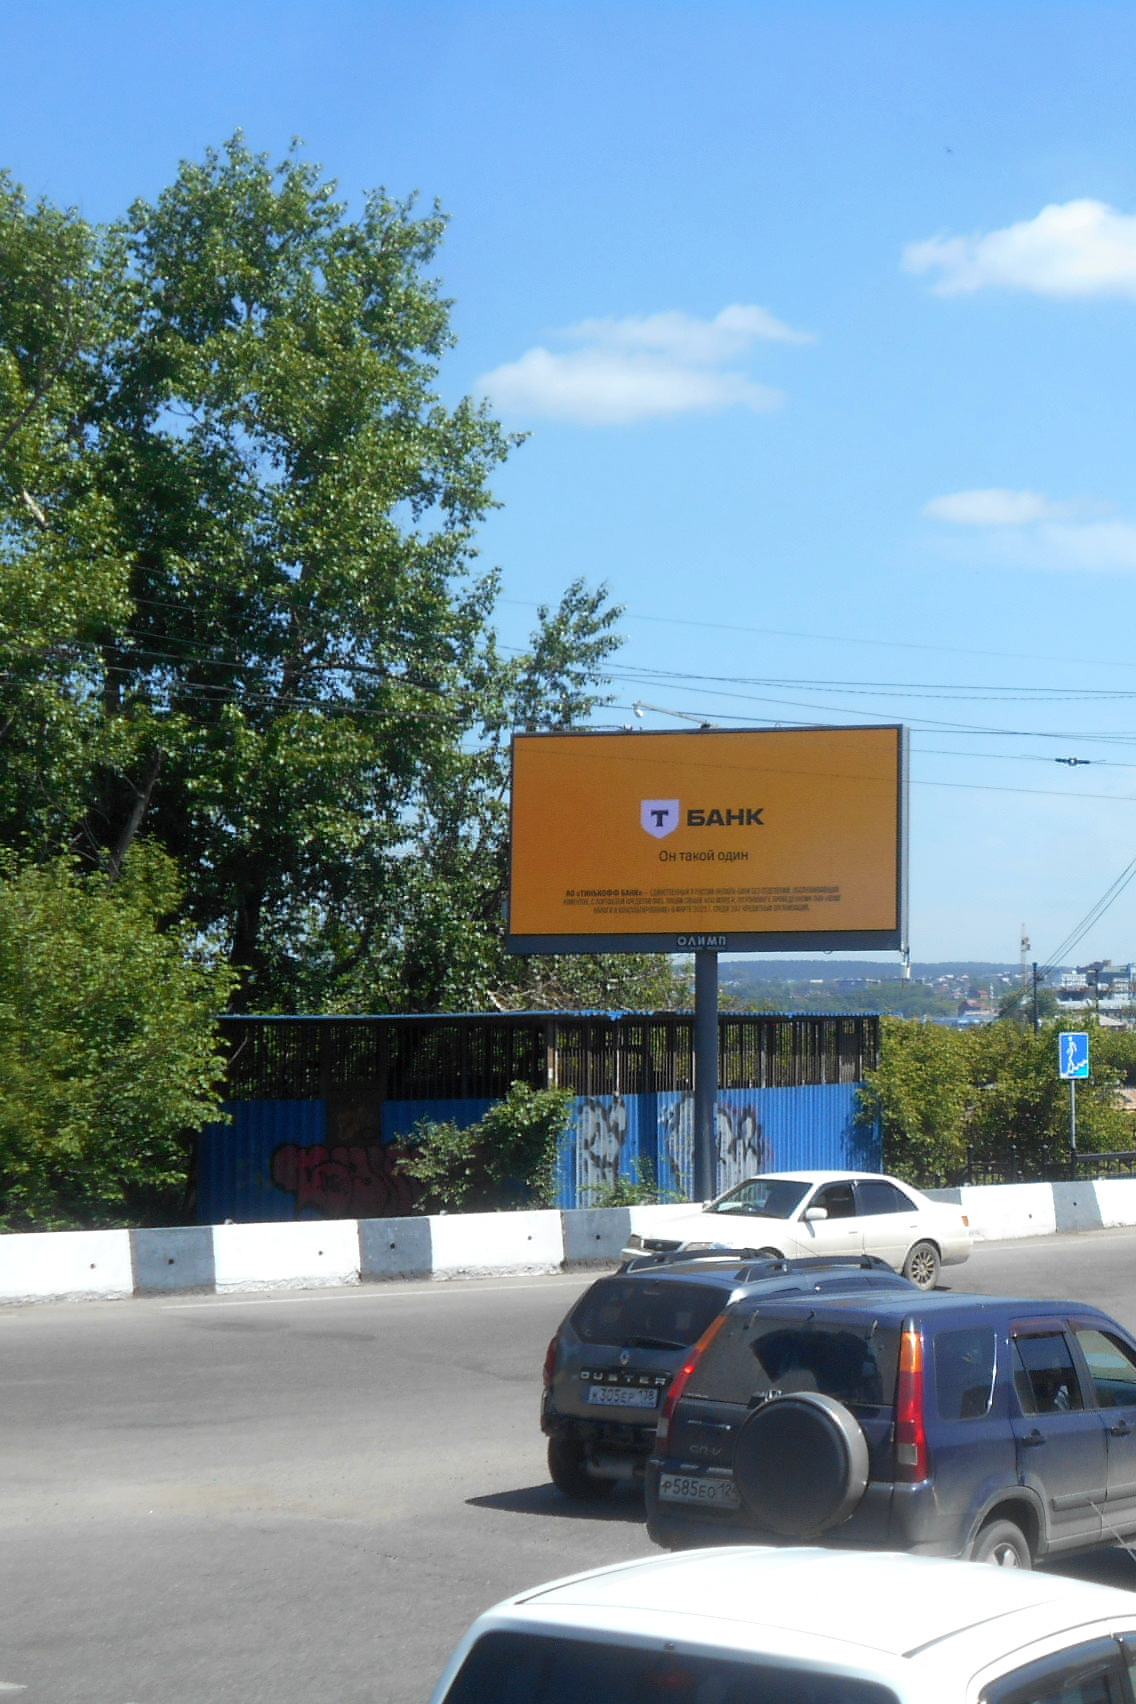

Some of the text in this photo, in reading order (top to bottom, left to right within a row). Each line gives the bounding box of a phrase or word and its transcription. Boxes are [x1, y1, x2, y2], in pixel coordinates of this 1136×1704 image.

[687, 808, 764, 827] БАНК
[659, 849, 749, 863] Он такой один
[677, 935, 727, 946] ОЛИМП
[580, 1371, 667, 1385] DUSTER
